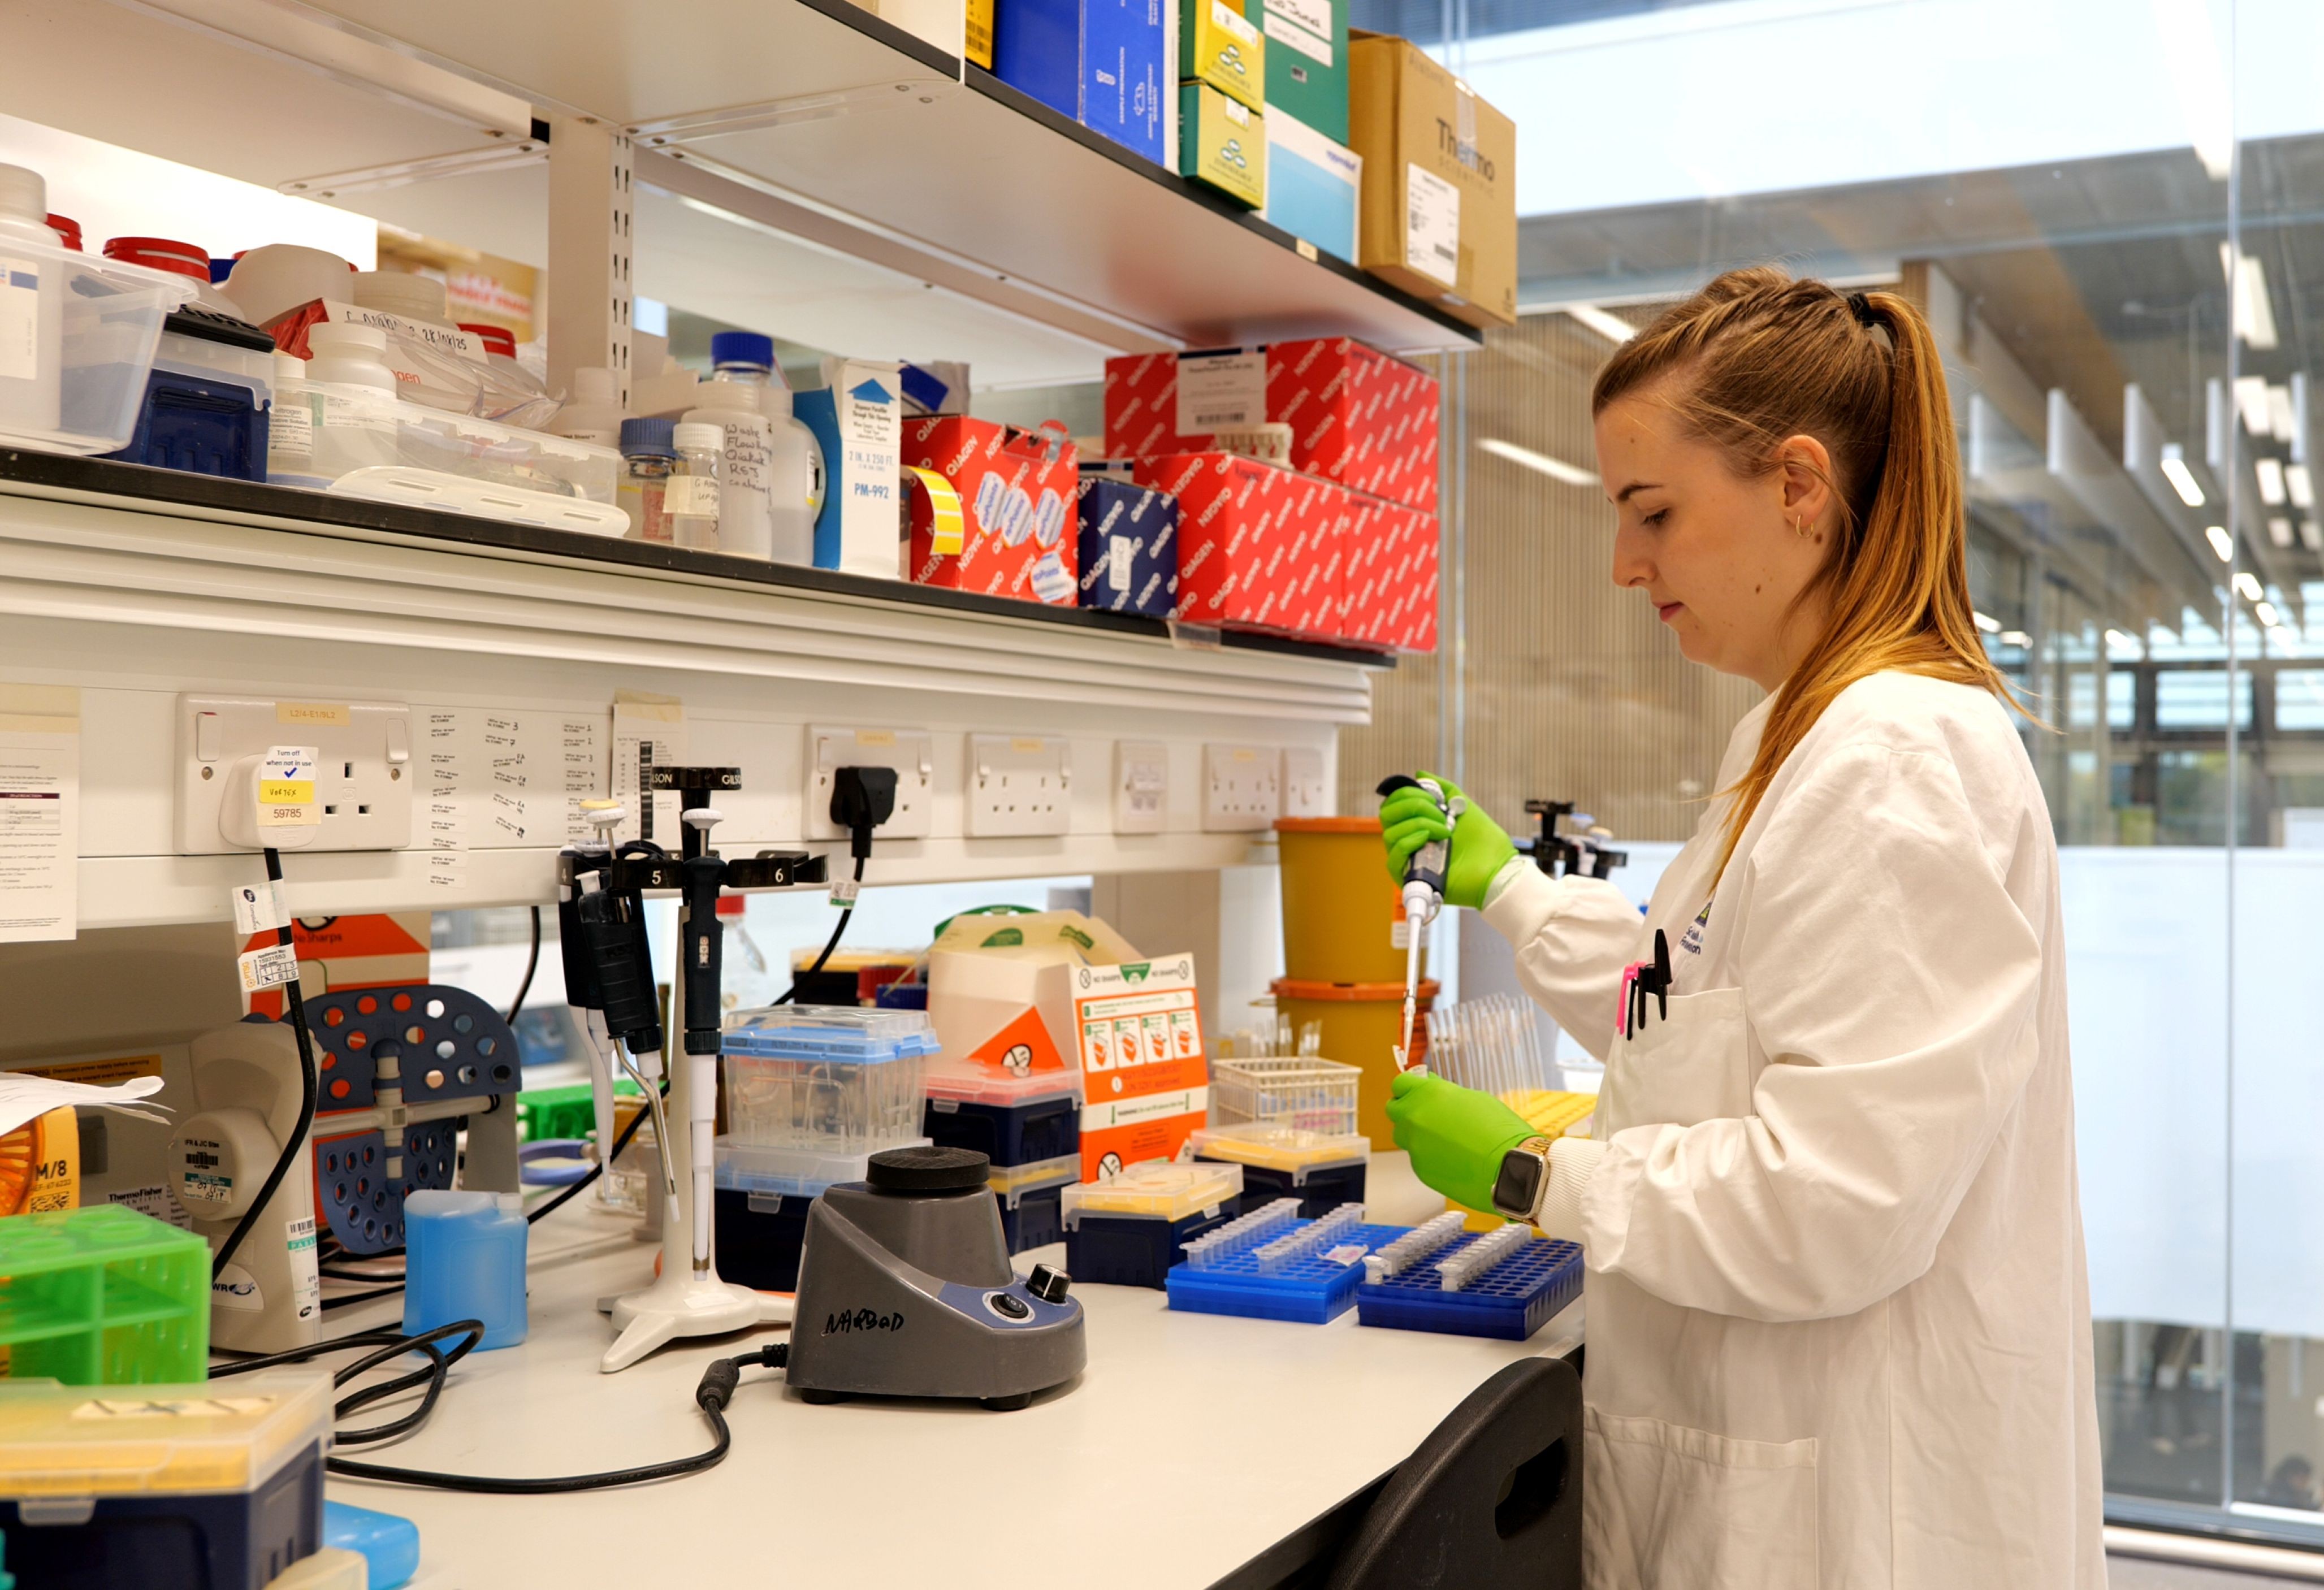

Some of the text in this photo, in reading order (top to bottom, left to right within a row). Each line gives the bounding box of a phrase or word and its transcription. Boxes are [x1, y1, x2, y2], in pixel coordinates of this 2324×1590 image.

[1436, 117, 1495, 182] Thermo
[275, 408, 302, 416] vitrogen
[725, 424, 760, 439] Waste
[872, 454, 884, 465] 250
[854, 483, 889, 499] PM-992
[651, 773, 673, 783] LSON
[274, 808, 302, 819] 59785
[651, 870, 661, 885] 5
[775, 868, 784, 883] 6
[213, 1283, 228, 1292] WR
